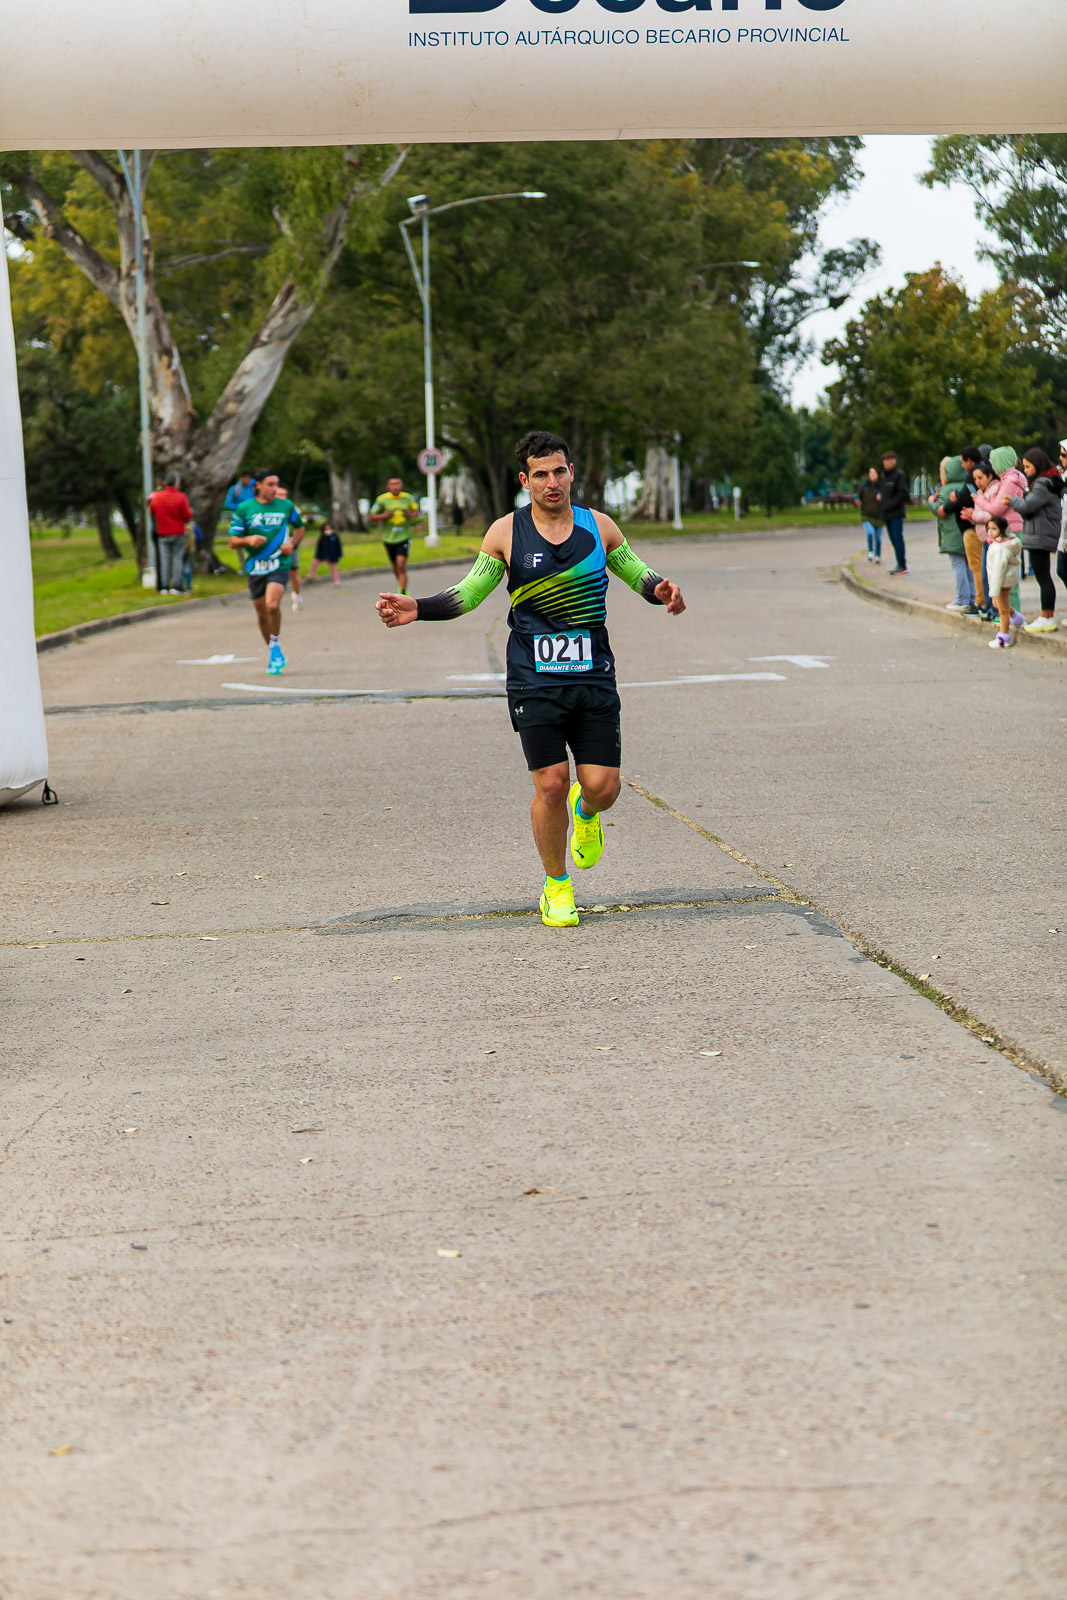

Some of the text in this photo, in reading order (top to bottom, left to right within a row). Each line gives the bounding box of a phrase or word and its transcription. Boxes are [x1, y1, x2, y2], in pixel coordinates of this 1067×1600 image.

[408, 27, 850, 47] INSTITUTO AUTÁRQUICO BECARIO PROVINCIAL
[523, 553, 543, 569] SF
[538, 633, 584, 664] 021
[570, 663, 590, 671] CORRE
